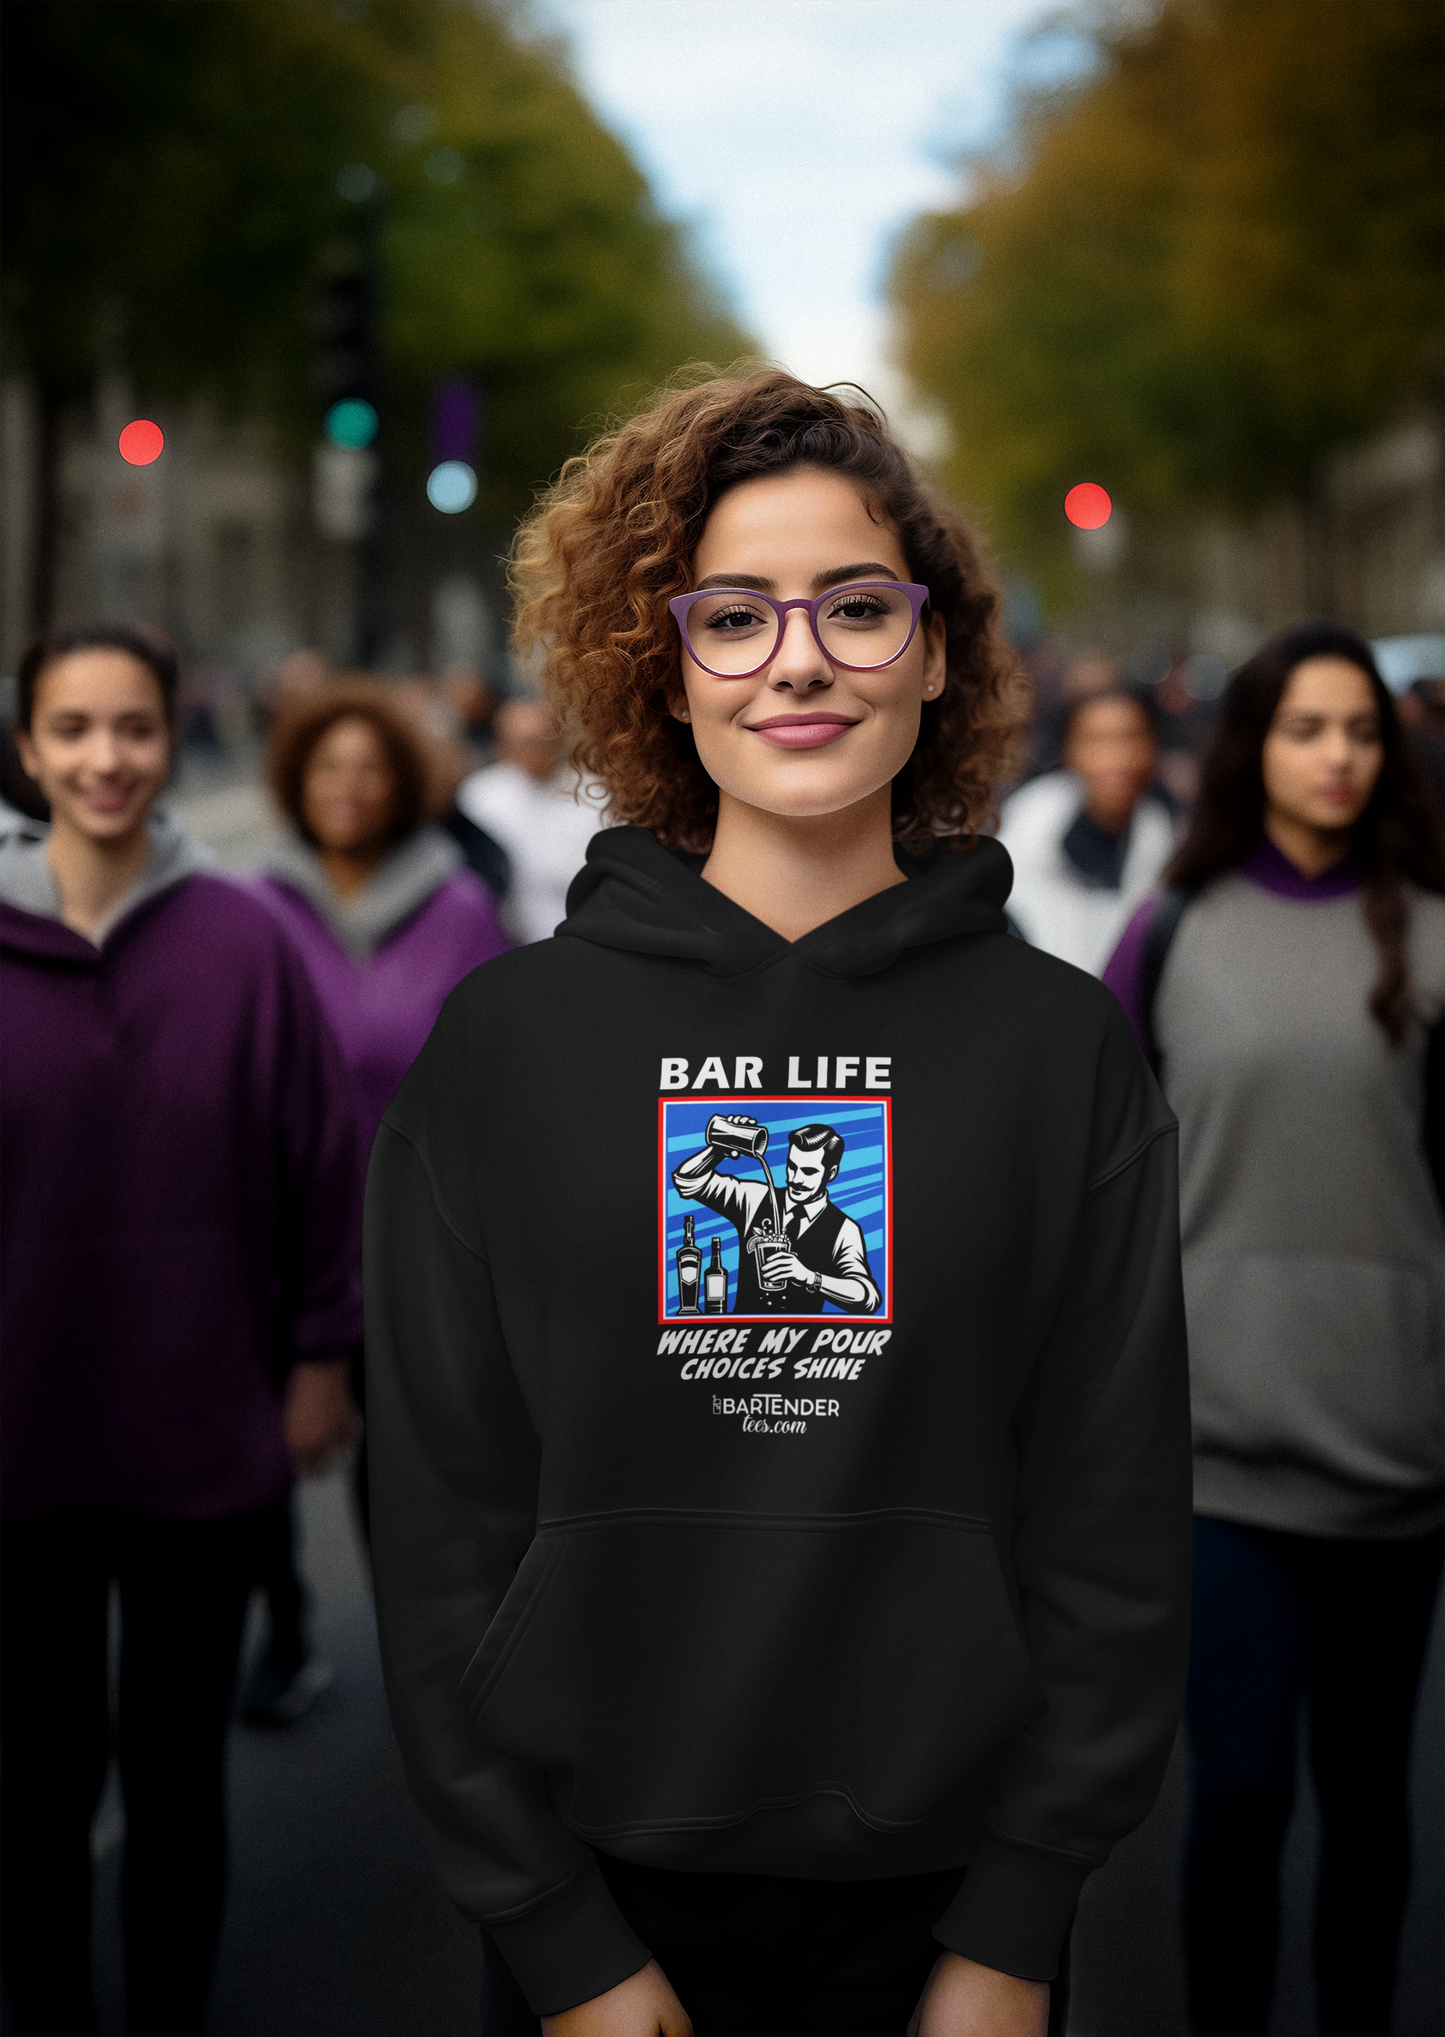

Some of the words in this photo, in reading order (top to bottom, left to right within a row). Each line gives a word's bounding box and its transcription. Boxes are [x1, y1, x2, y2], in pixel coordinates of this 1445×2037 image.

[659, 1056, 764, 1090] BAR
[787, 1056, 892, 1090] LIFE
[656, 1328, 752, 1356] WHERE
[757, 1326, 809, 1355] MY
[809, 1328, 893, 1357] POUR
[680, 1357, 787, 1381] CHOICES
[793, 1357, 867, 1381] SHINE
[722, 1393, 840, 1417] BARTENDER
[742, 1414, 808, 1434] tees.com
